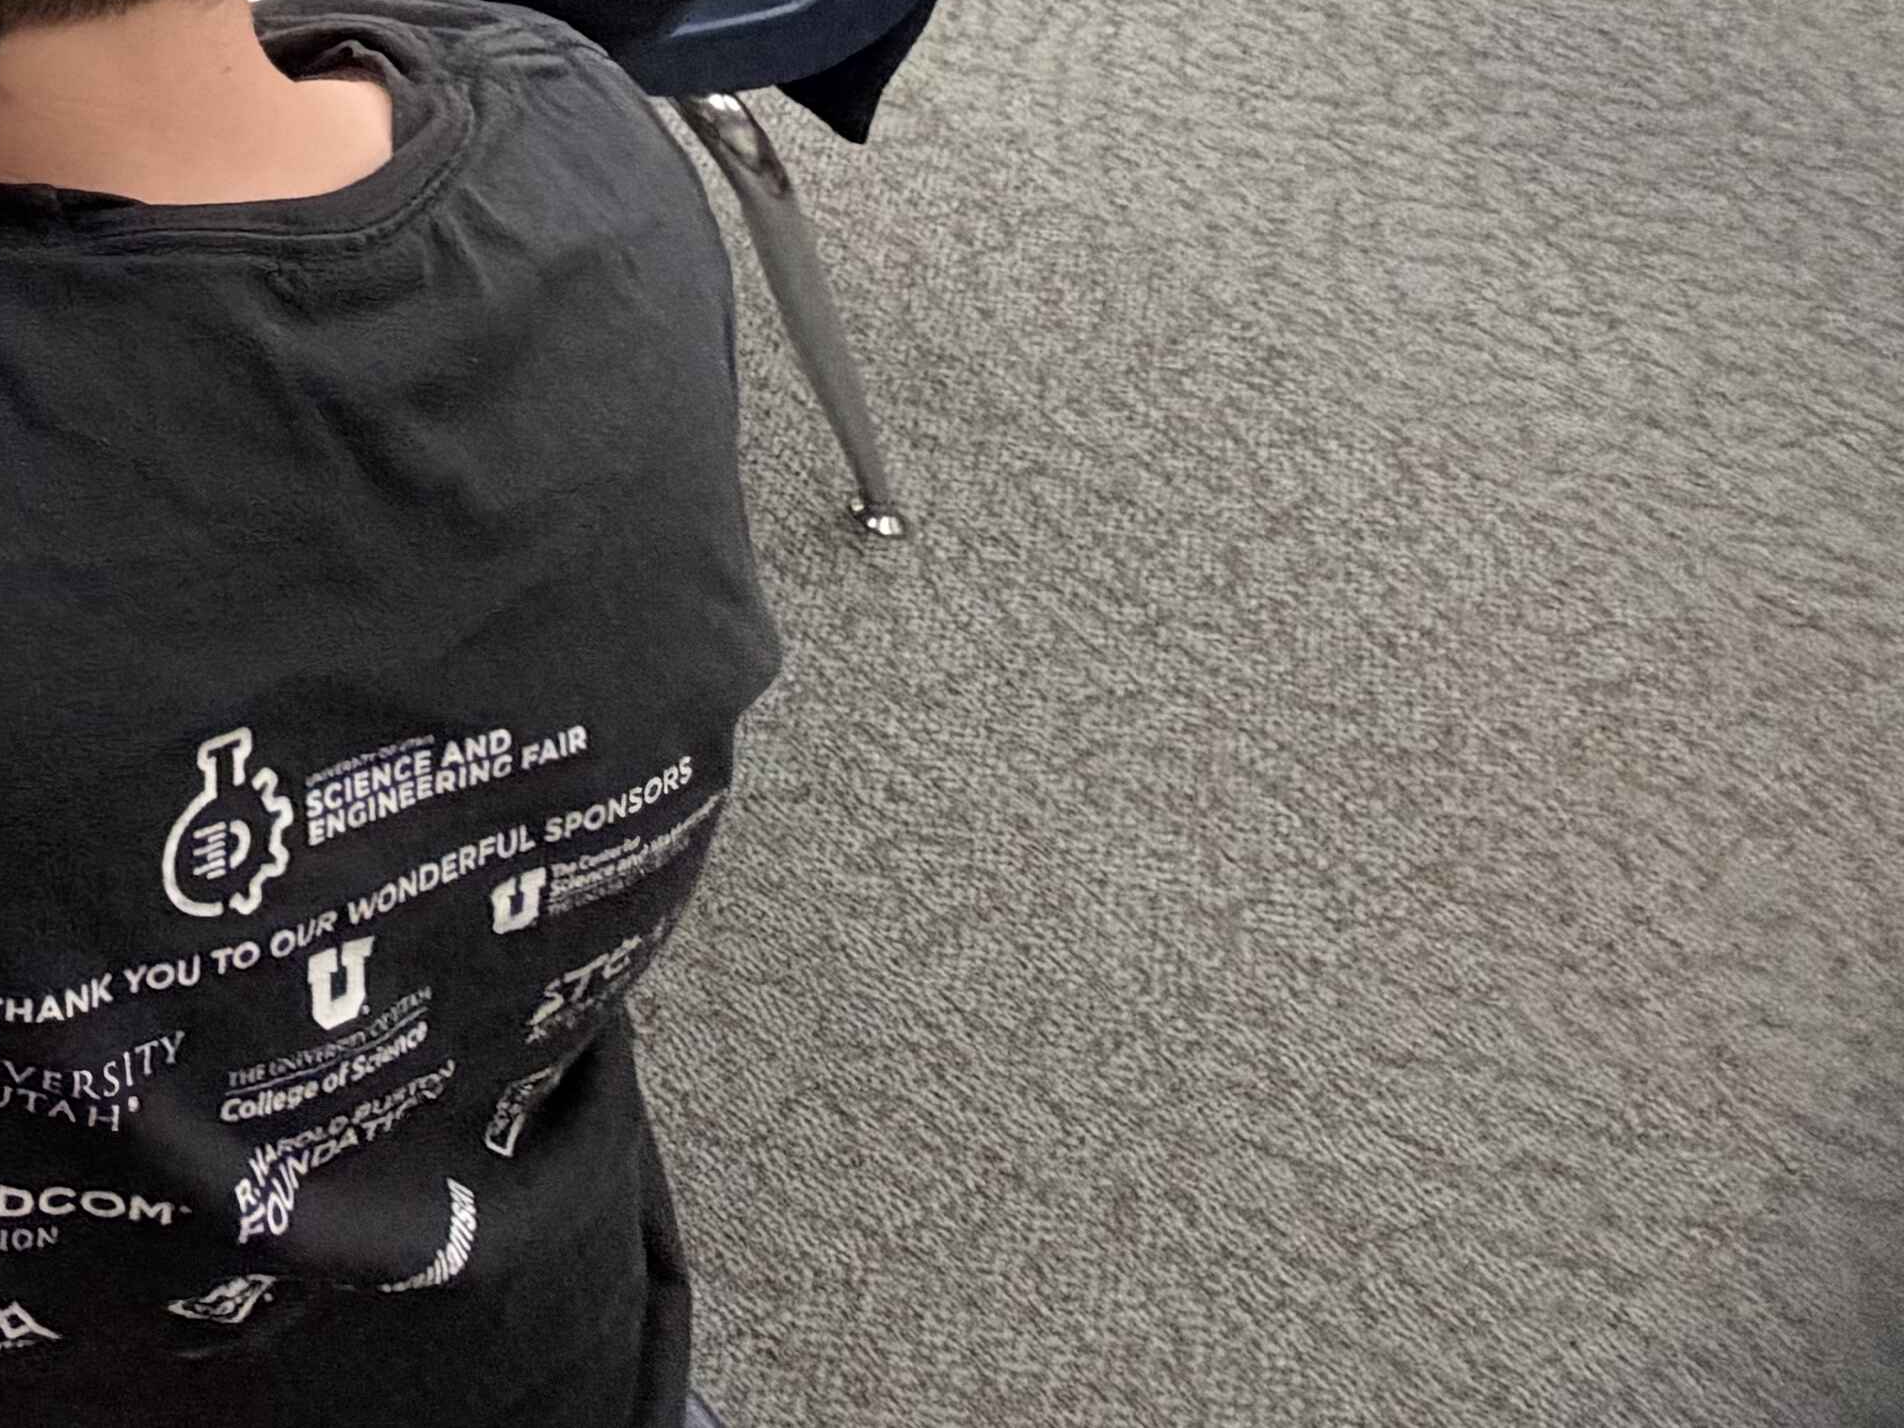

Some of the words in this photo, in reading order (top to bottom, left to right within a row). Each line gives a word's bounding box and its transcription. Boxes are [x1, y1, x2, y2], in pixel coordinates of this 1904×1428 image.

[306, 750, 432, 818] SCIENCE
[441, 728, 512, 767] AND
[308, 755, 512, 846] ENGINEERING
[521, 725, 588, 771] FAIR
[123, 955, 201, 993] YOU
[210, 941, 260, 974] TO
[270, 912, 339, 959] OUR
[347, 825, 537, 928] WONDERFUL
[545, 755, 694, 844] SPONSORS
[490, 867, 546, 935] U
[308, 936, 375, 1031] U
[220, 1080, 320, 1122] College
[321, 1060, 350, 1094] of
[350, 1020, 429, 1082] Science
[228, 1064, 266, 1087] THE
